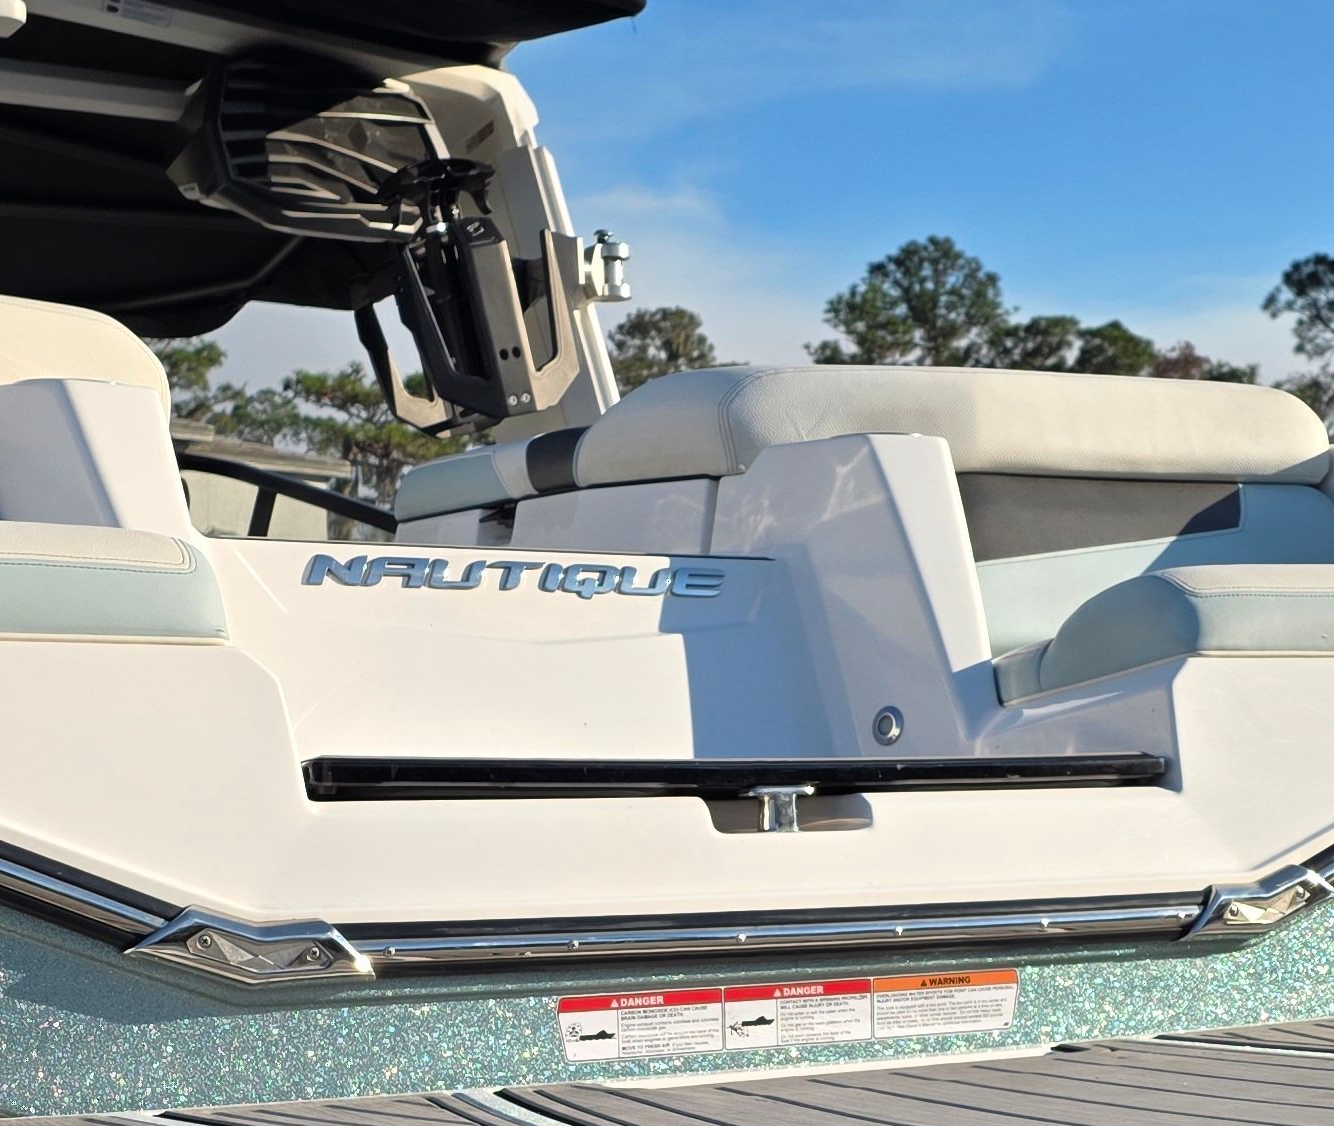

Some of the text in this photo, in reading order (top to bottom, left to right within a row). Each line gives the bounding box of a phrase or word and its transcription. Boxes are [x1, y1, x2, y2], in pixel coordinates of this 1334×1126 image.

[301, 553, 725, 600] NAUTIQUE
[929, 976, 971, 986] WARNING
[783, 986, 824, 996] DANGER
[620, 995, 664, 1007] DANGER
